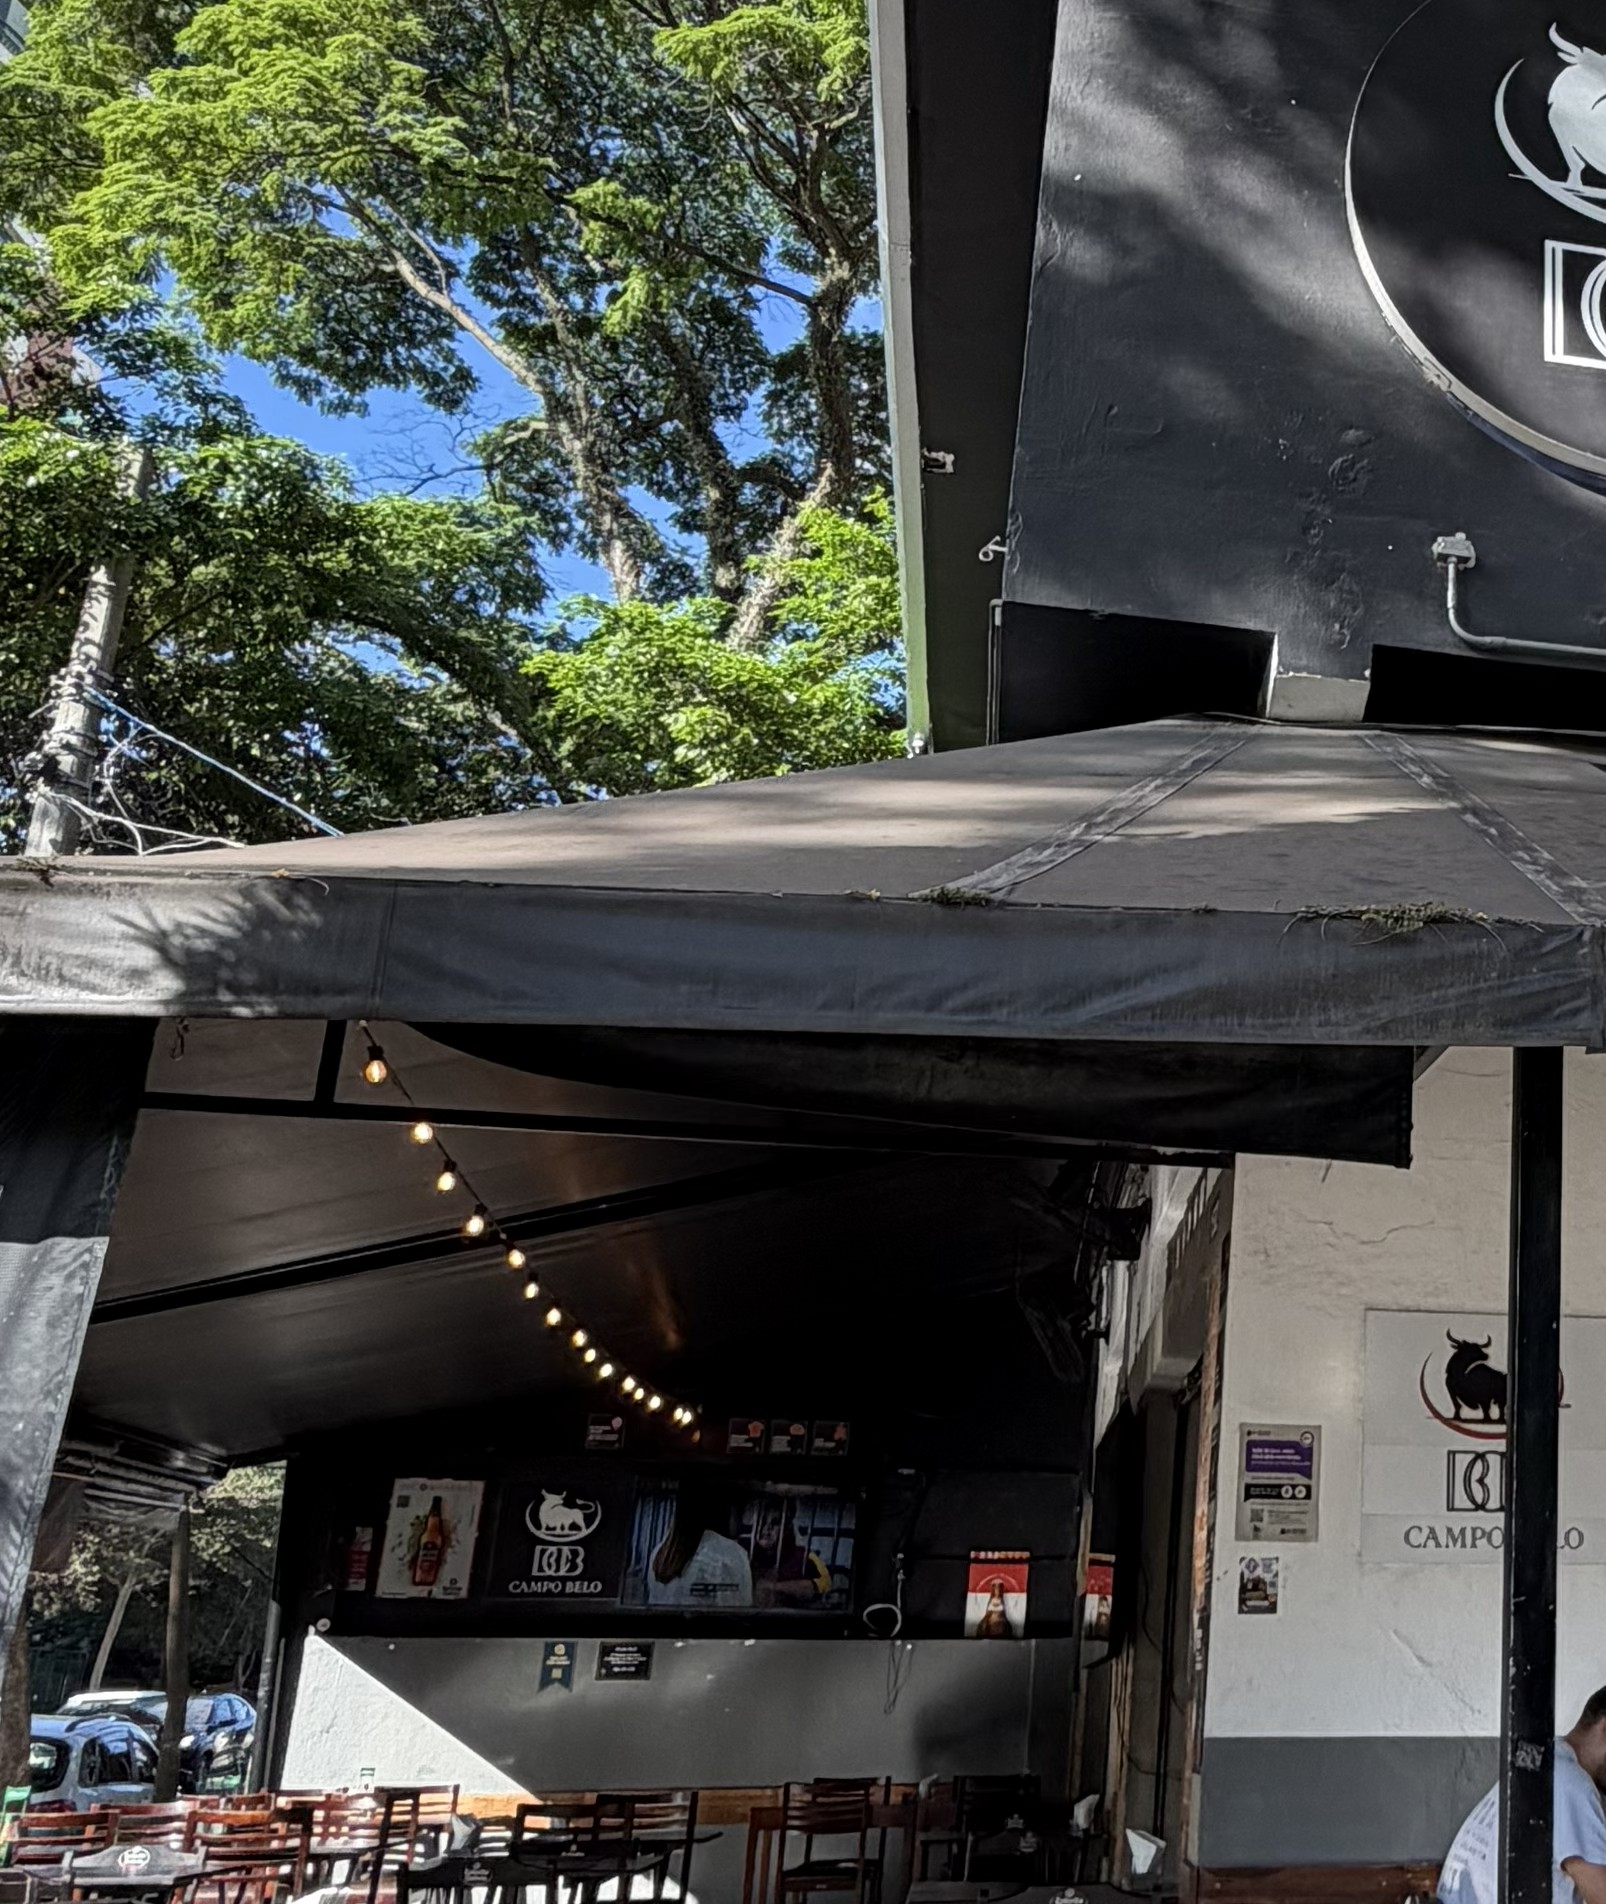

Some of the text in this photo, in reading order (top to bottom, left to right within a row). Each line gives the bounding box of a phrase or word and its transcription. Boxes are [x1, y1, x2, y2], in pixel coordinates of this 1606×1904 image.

[1404, 1525, 1505, 1549] CAMPO
[508, 1581, 603, 1594] CAMPO BELO
